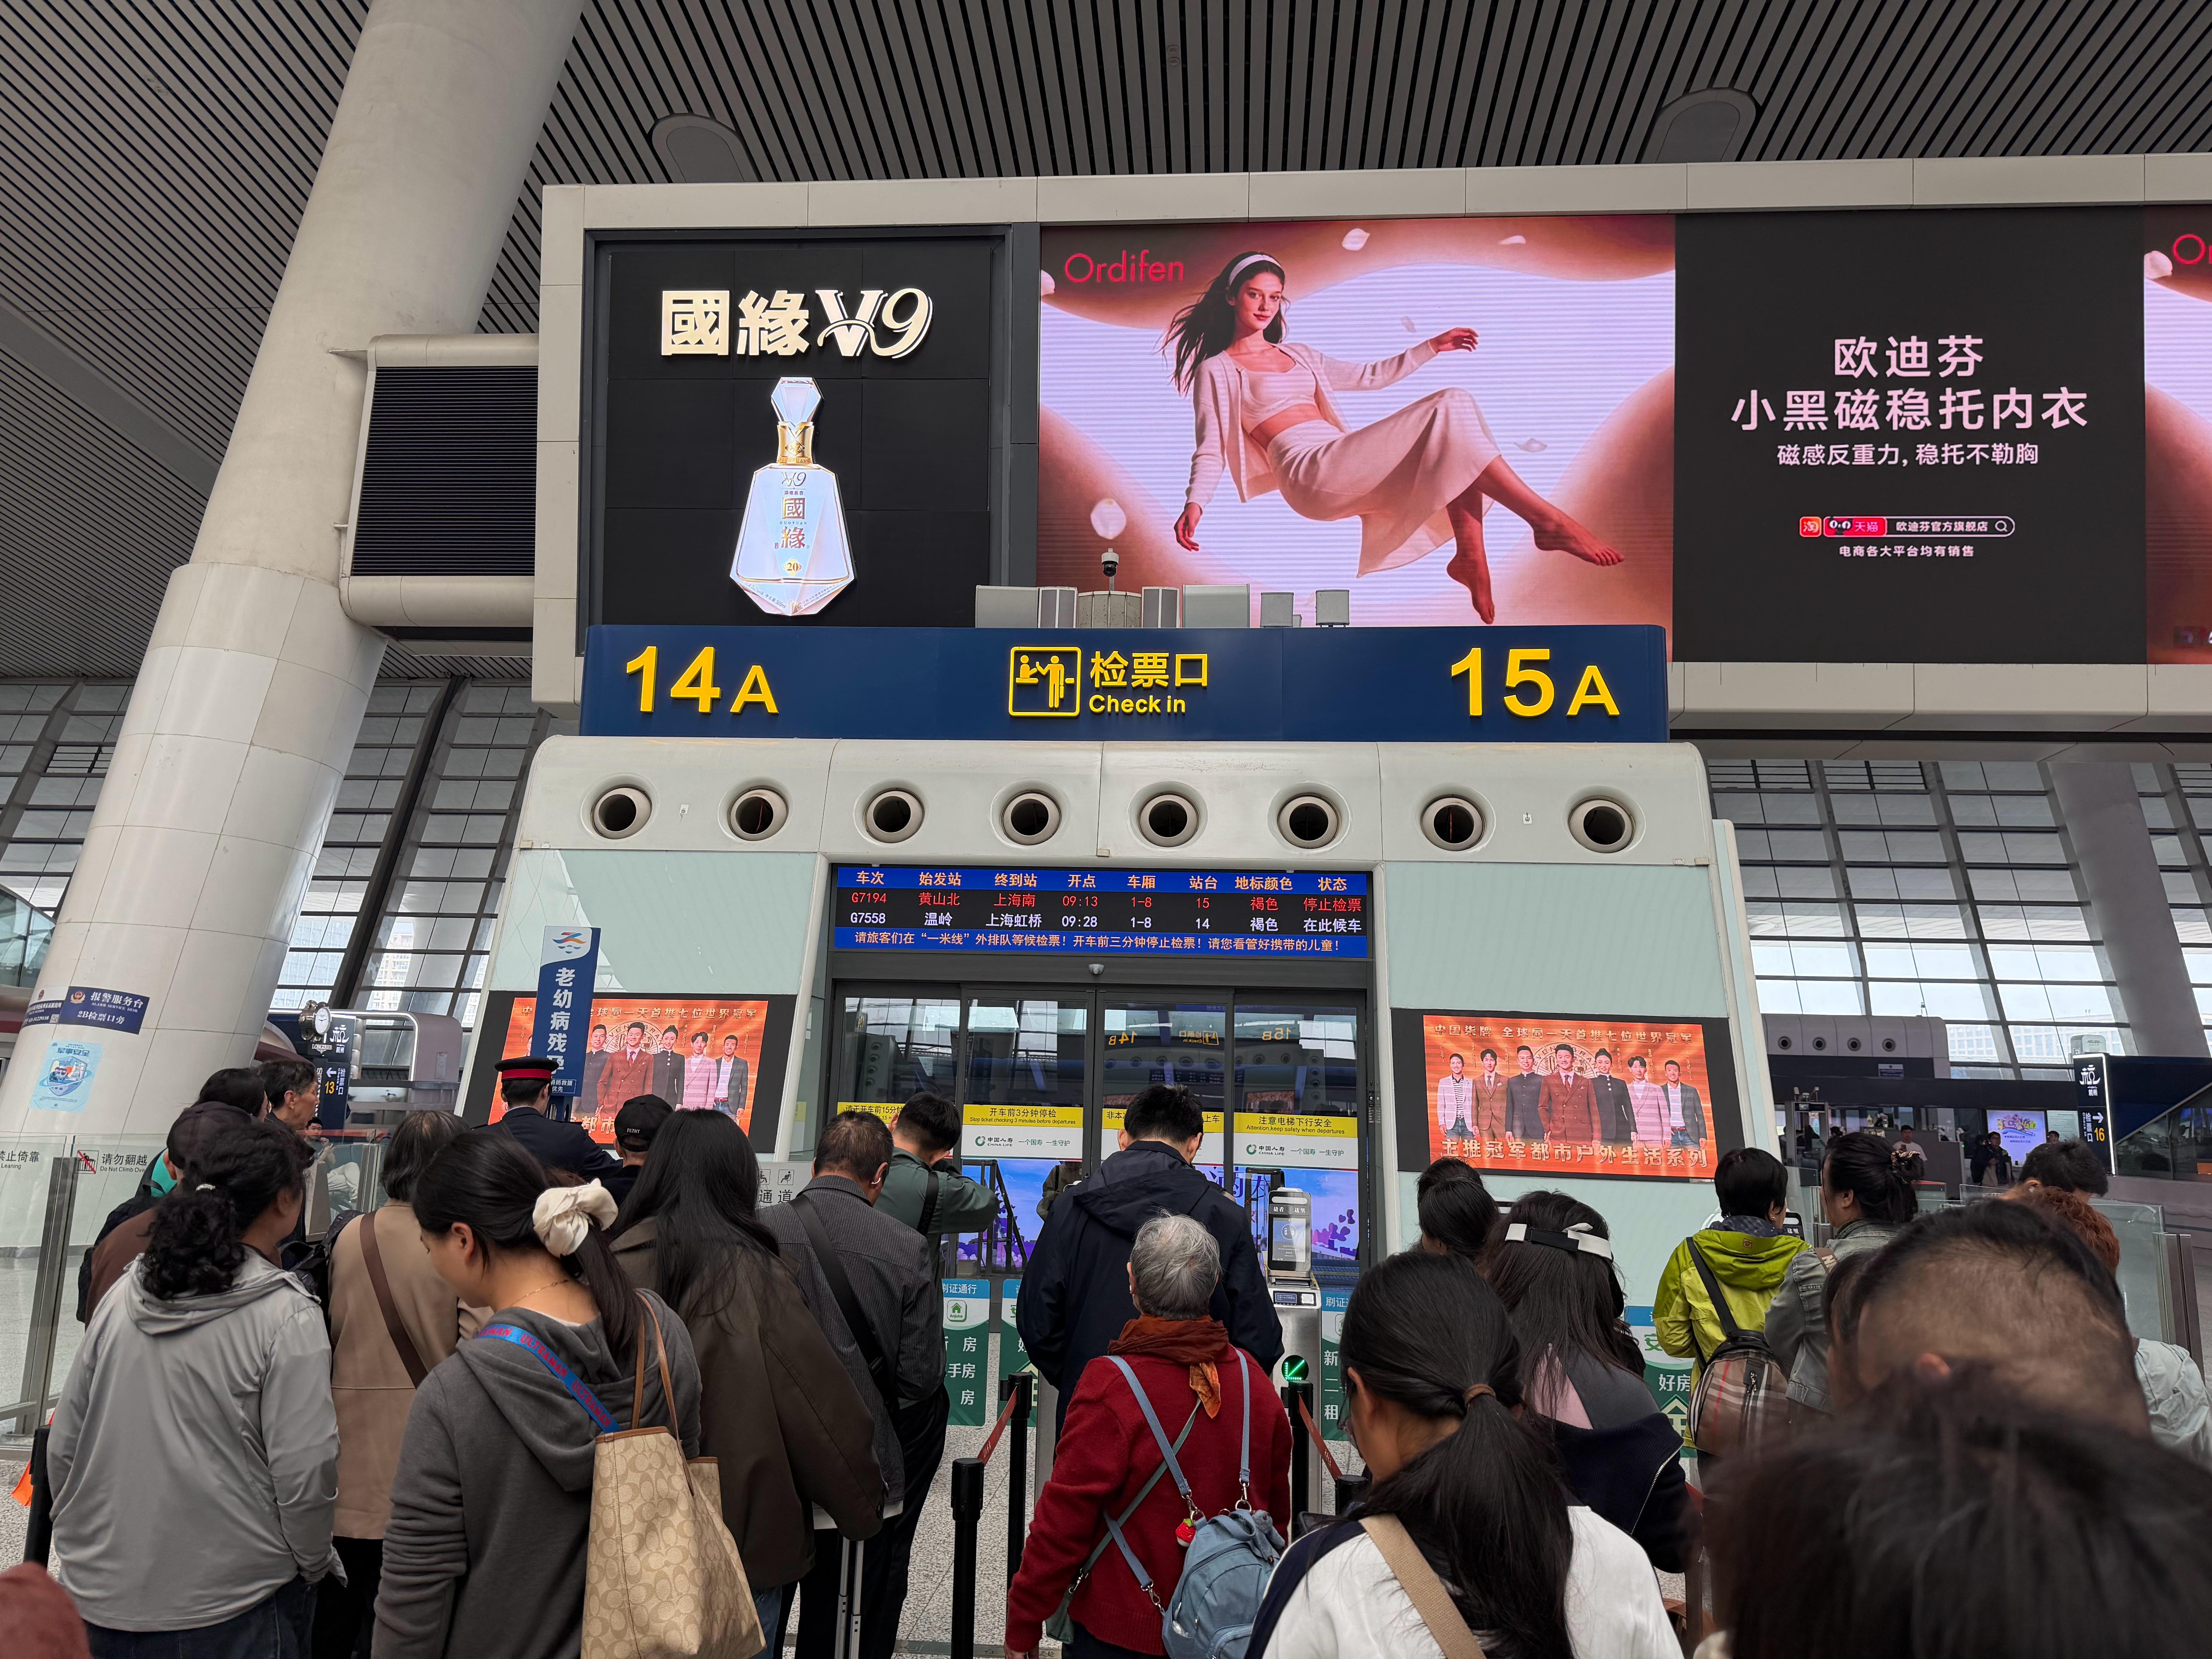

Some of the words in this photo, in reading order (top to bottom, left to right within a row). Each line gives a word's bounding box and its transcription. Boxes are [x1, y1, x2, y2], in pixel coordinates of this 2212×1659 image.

[1065, 250, 1184, 282] Ordifen
[1834, 335, 1984, 378] 欧迪芬
[1731, 387, 2088, 431] 小黑磁稳托内衣
[781, 472, 806, 487] V9
[782, 497, 805, 519] 國
[1802, 521, 1819, 533] 淘
[1855, 521, 1879, 532] 天猫
[1896, 521, 1989, 532] 欧迪芬官方旗舰店
[781, 526, 805, 548] 緣
[1839, 546, 1974, 557] 电商各大平台均有销售
[787, 563, 799, 571] 20
[1091, 651, 1208, 688] 检票口
[1089, 695, 1161, 714] Check
[1167, 696, 1186, 714] in
[856, 871, 884, 885] 车次
[919, 872, 962, 886] 始发站
[995, 873, 1037, 887] 终到站
[1068, 874, 1096, 888] 开点
[1127, 875, 1156, 889] 车厢
[1189, 876, 1218, 890] 站台
[1235, 876, 1293, 891] 地标颜色
[1318, 877, 1347, 891] 状态
[852, 892, 887, 904] G7194
[918, 892, 960, 906] 黄山北
[994, 893, 1036, 907] 上海南
[1062, 895, 1098, 907] 09:13
[1131, 896, 1152, 908] 1-8
[1196, 898, 1210, 908] 15
[1250, 897, 1278, 910] 褐色
[1304, 897, 1362, 912] 停止检票
[850, 912, 886, 924] G7558
[924, 912, 953, 926] 温岭
[986, 914, 1042, 928] 上海虹桥
[1061, 916, 1097, 927] 09:28
[1130, 917, 1152, 928] 1-8
[1196, 918, 1210, 929] 14
[1250, 917, 1278, 931] 褐色
[1304, 918, 1362, 933] 在此候车
[90, 991, 144, 1008] 报警服务台
[77, 1011, 125, 1024] 2B检票口旁
[325, 1081, 335, 1094] 13
[989, 1108, 1056, 1118] 开车前3分钟停检
[1204, 1114, 1220, 1123] 上车
[1259, 1116, 1332, 1127] 注意电梯下行安全
[2094, 1127, 2105, 1142] 16
[102, 1153, 148, 1166] 请勿翻越
[1440, 1139, 1708, 1168] 主推冠军都市户外生活系列
[519, 1333, 569, 1378] ULTRAMAN
[945, 1362, 976, 1379] 手房
[571, 1379, 612, 1429] ULTRAMAN
[1324, 1404, 1339, 1420] 租
